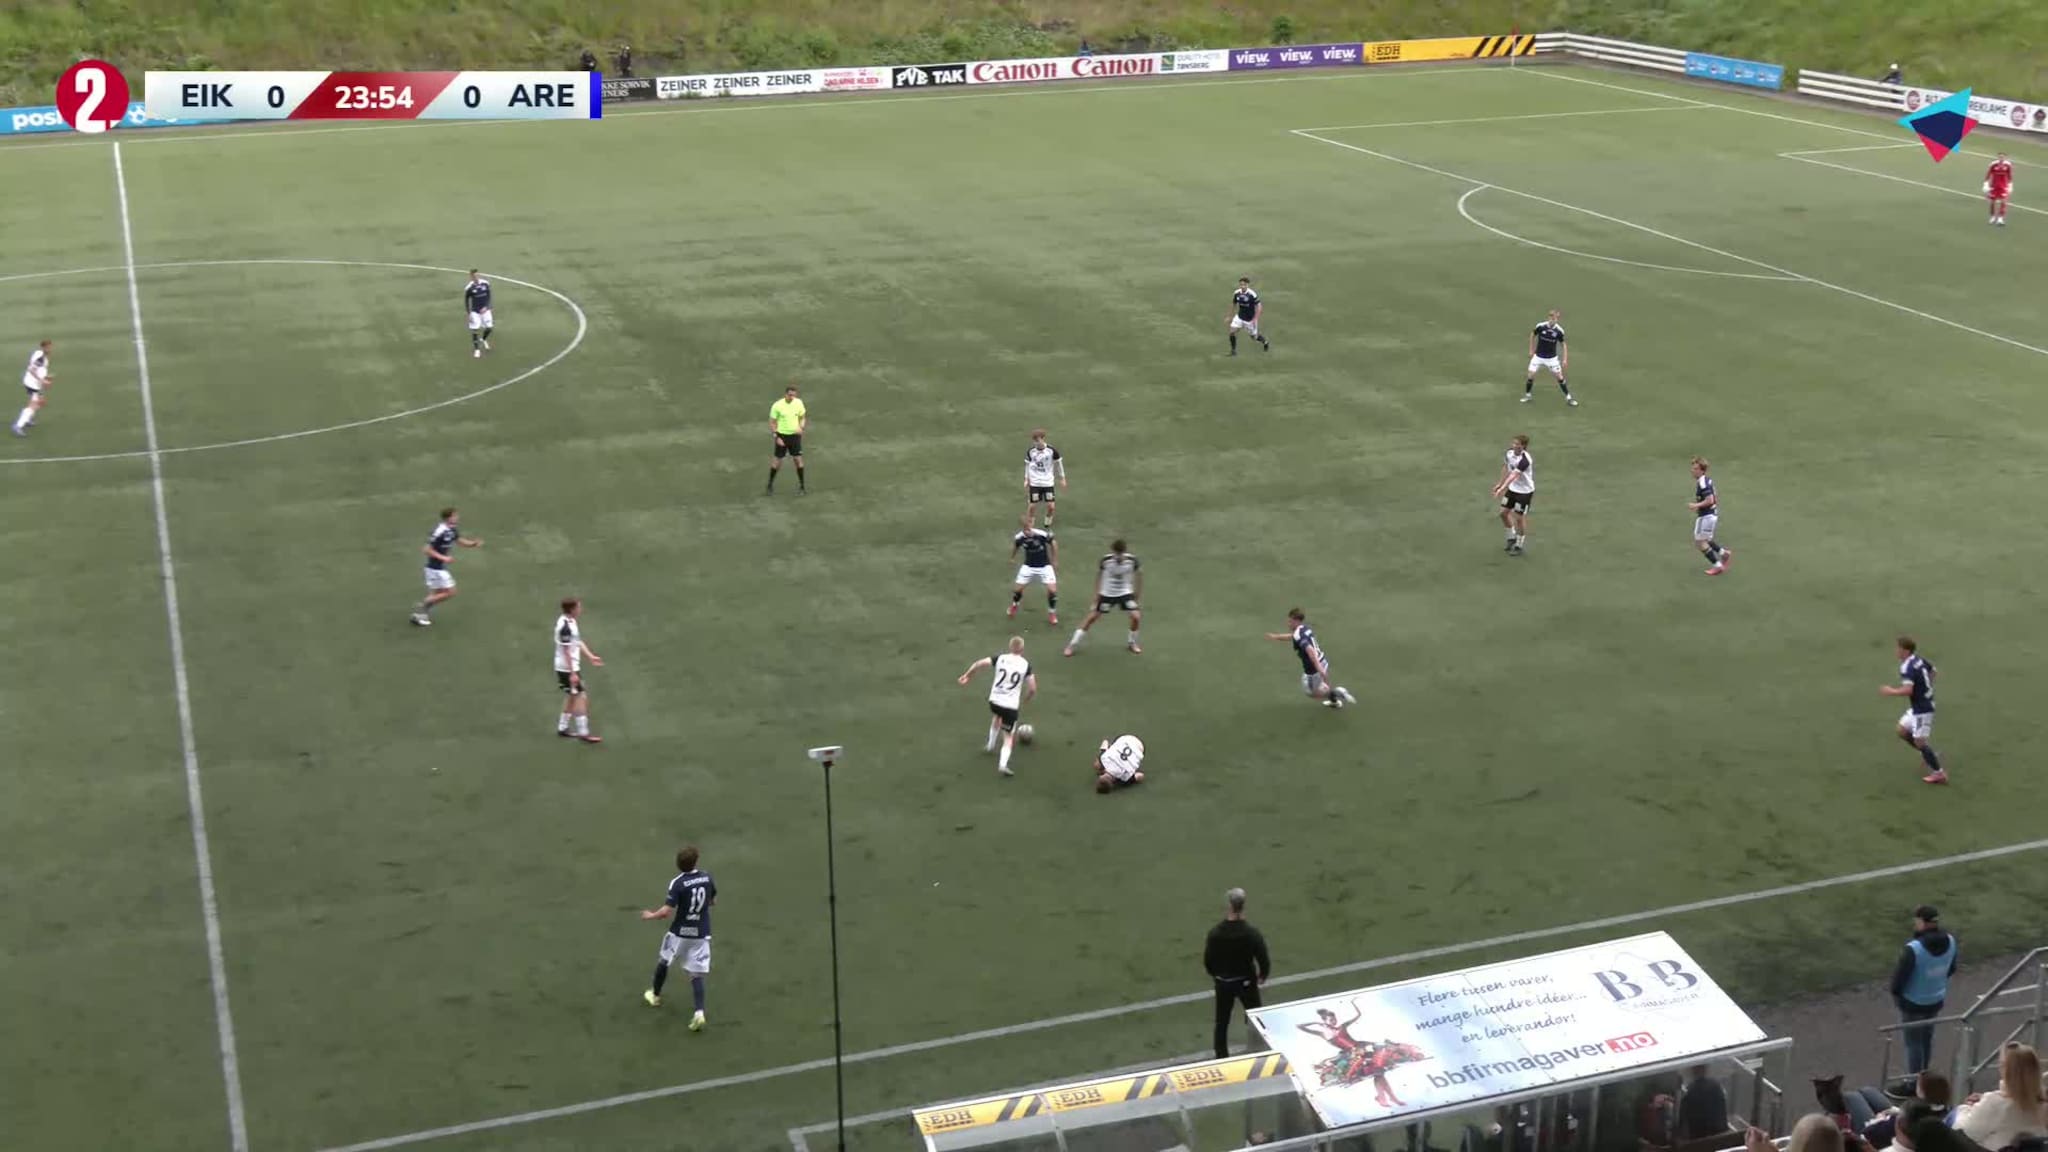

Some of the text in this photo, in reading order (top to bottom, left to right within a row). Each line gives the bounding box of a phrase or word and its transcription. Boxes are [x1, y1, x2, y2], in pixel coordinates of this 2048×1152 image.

[1375, 46, 1400, 56] EDH
[973, 62, 1057, 82] Canon
[1073, 58, 1154, 77] Canon
[713, 76, 760, 89] ZEINER
[766, 74, 812, 86] ZEINER
[932, 69, 965, 84] TAK
[661, 79, 708, 92] ZEINER
[995, 668, 1021, 690] 29
[1119, 746, 1133, 761] 8
[689, 887, 706, 913] 19
[1417, 989, 1460, 1007] Flere
[1462, 982, 1505, 997] tusen
[1416, 1010, 1472, 1031] mange
[1473, 998, 1534, 1017] hundre
[1461, 1032, 1483, 1043] en
[1184, 1068, 1224, 1082] EDH
[1061, 1088, 1102, 1103] EDH
[930, 1110, 973, 1125] EDH
